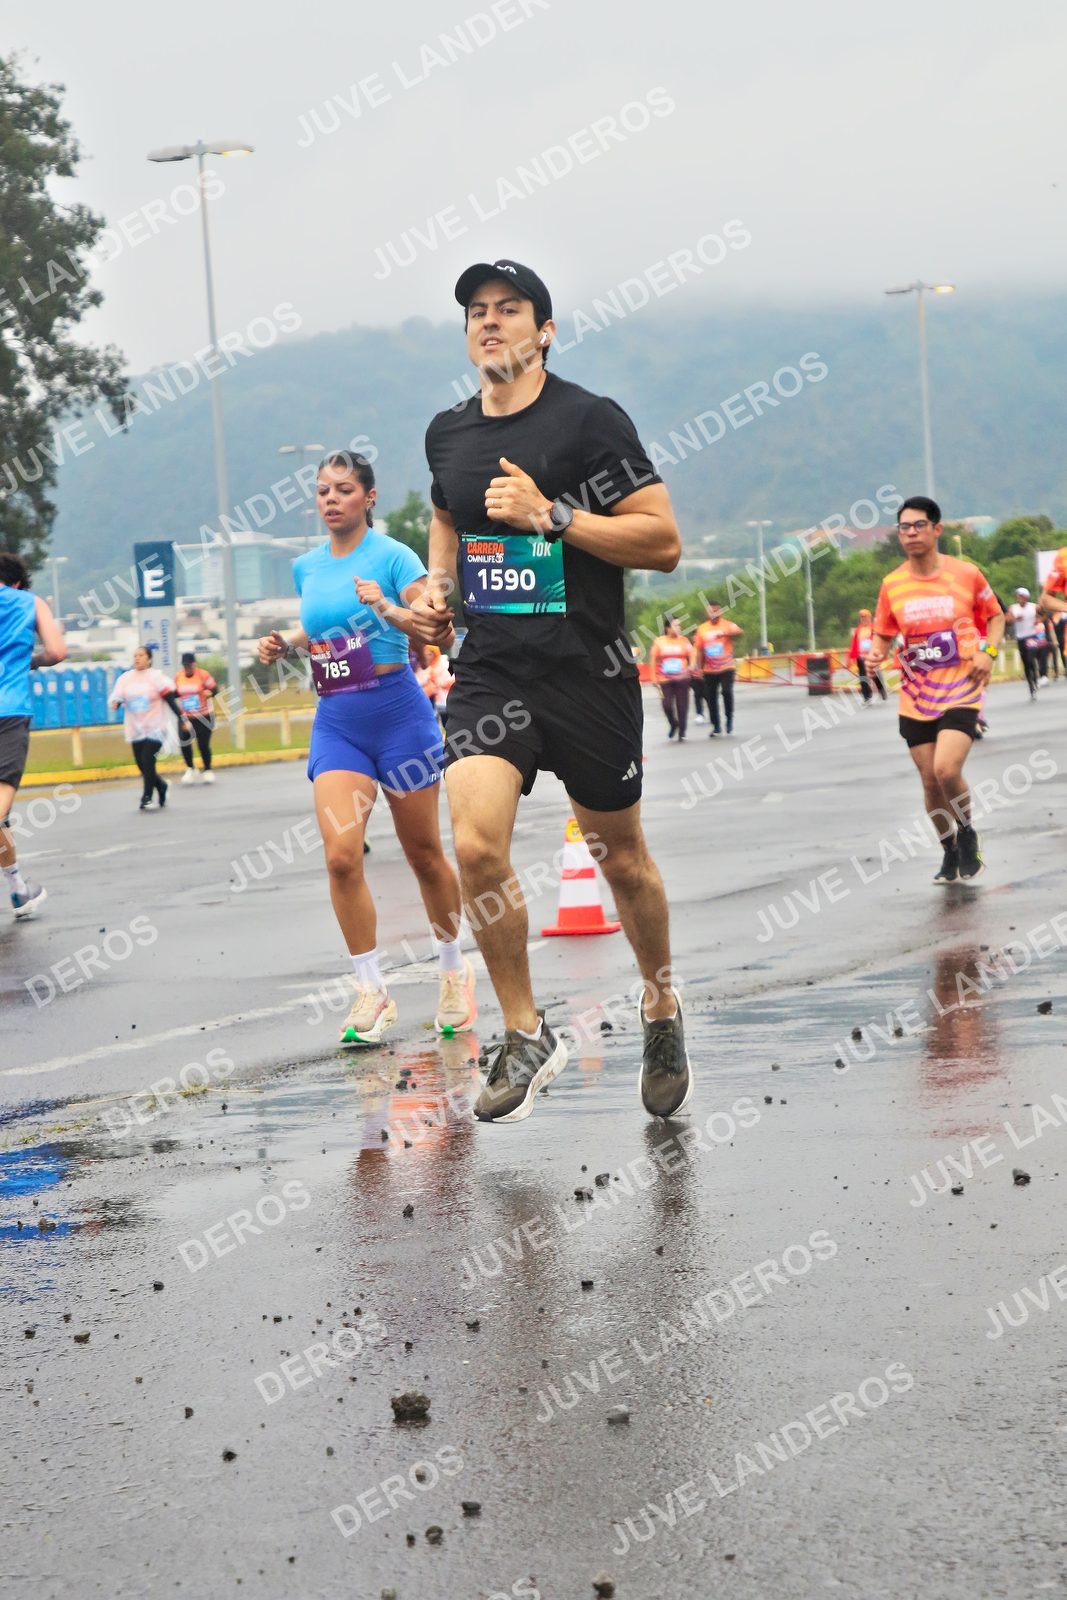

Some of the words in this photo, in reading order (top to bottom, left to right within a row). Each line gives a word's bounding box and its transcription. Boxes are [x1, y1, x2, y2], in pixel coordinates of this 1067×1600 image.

[467, 542, 504, 554] CARRERA
[532, 542, 552, 557] 10K
[143, 569, 165, 600] E
[477, 568, 535, 591] 1590
[346, 637, 362, 650] 15K
[918, 646, 942, 661] 306
[321, 660, 350, 679] 785
